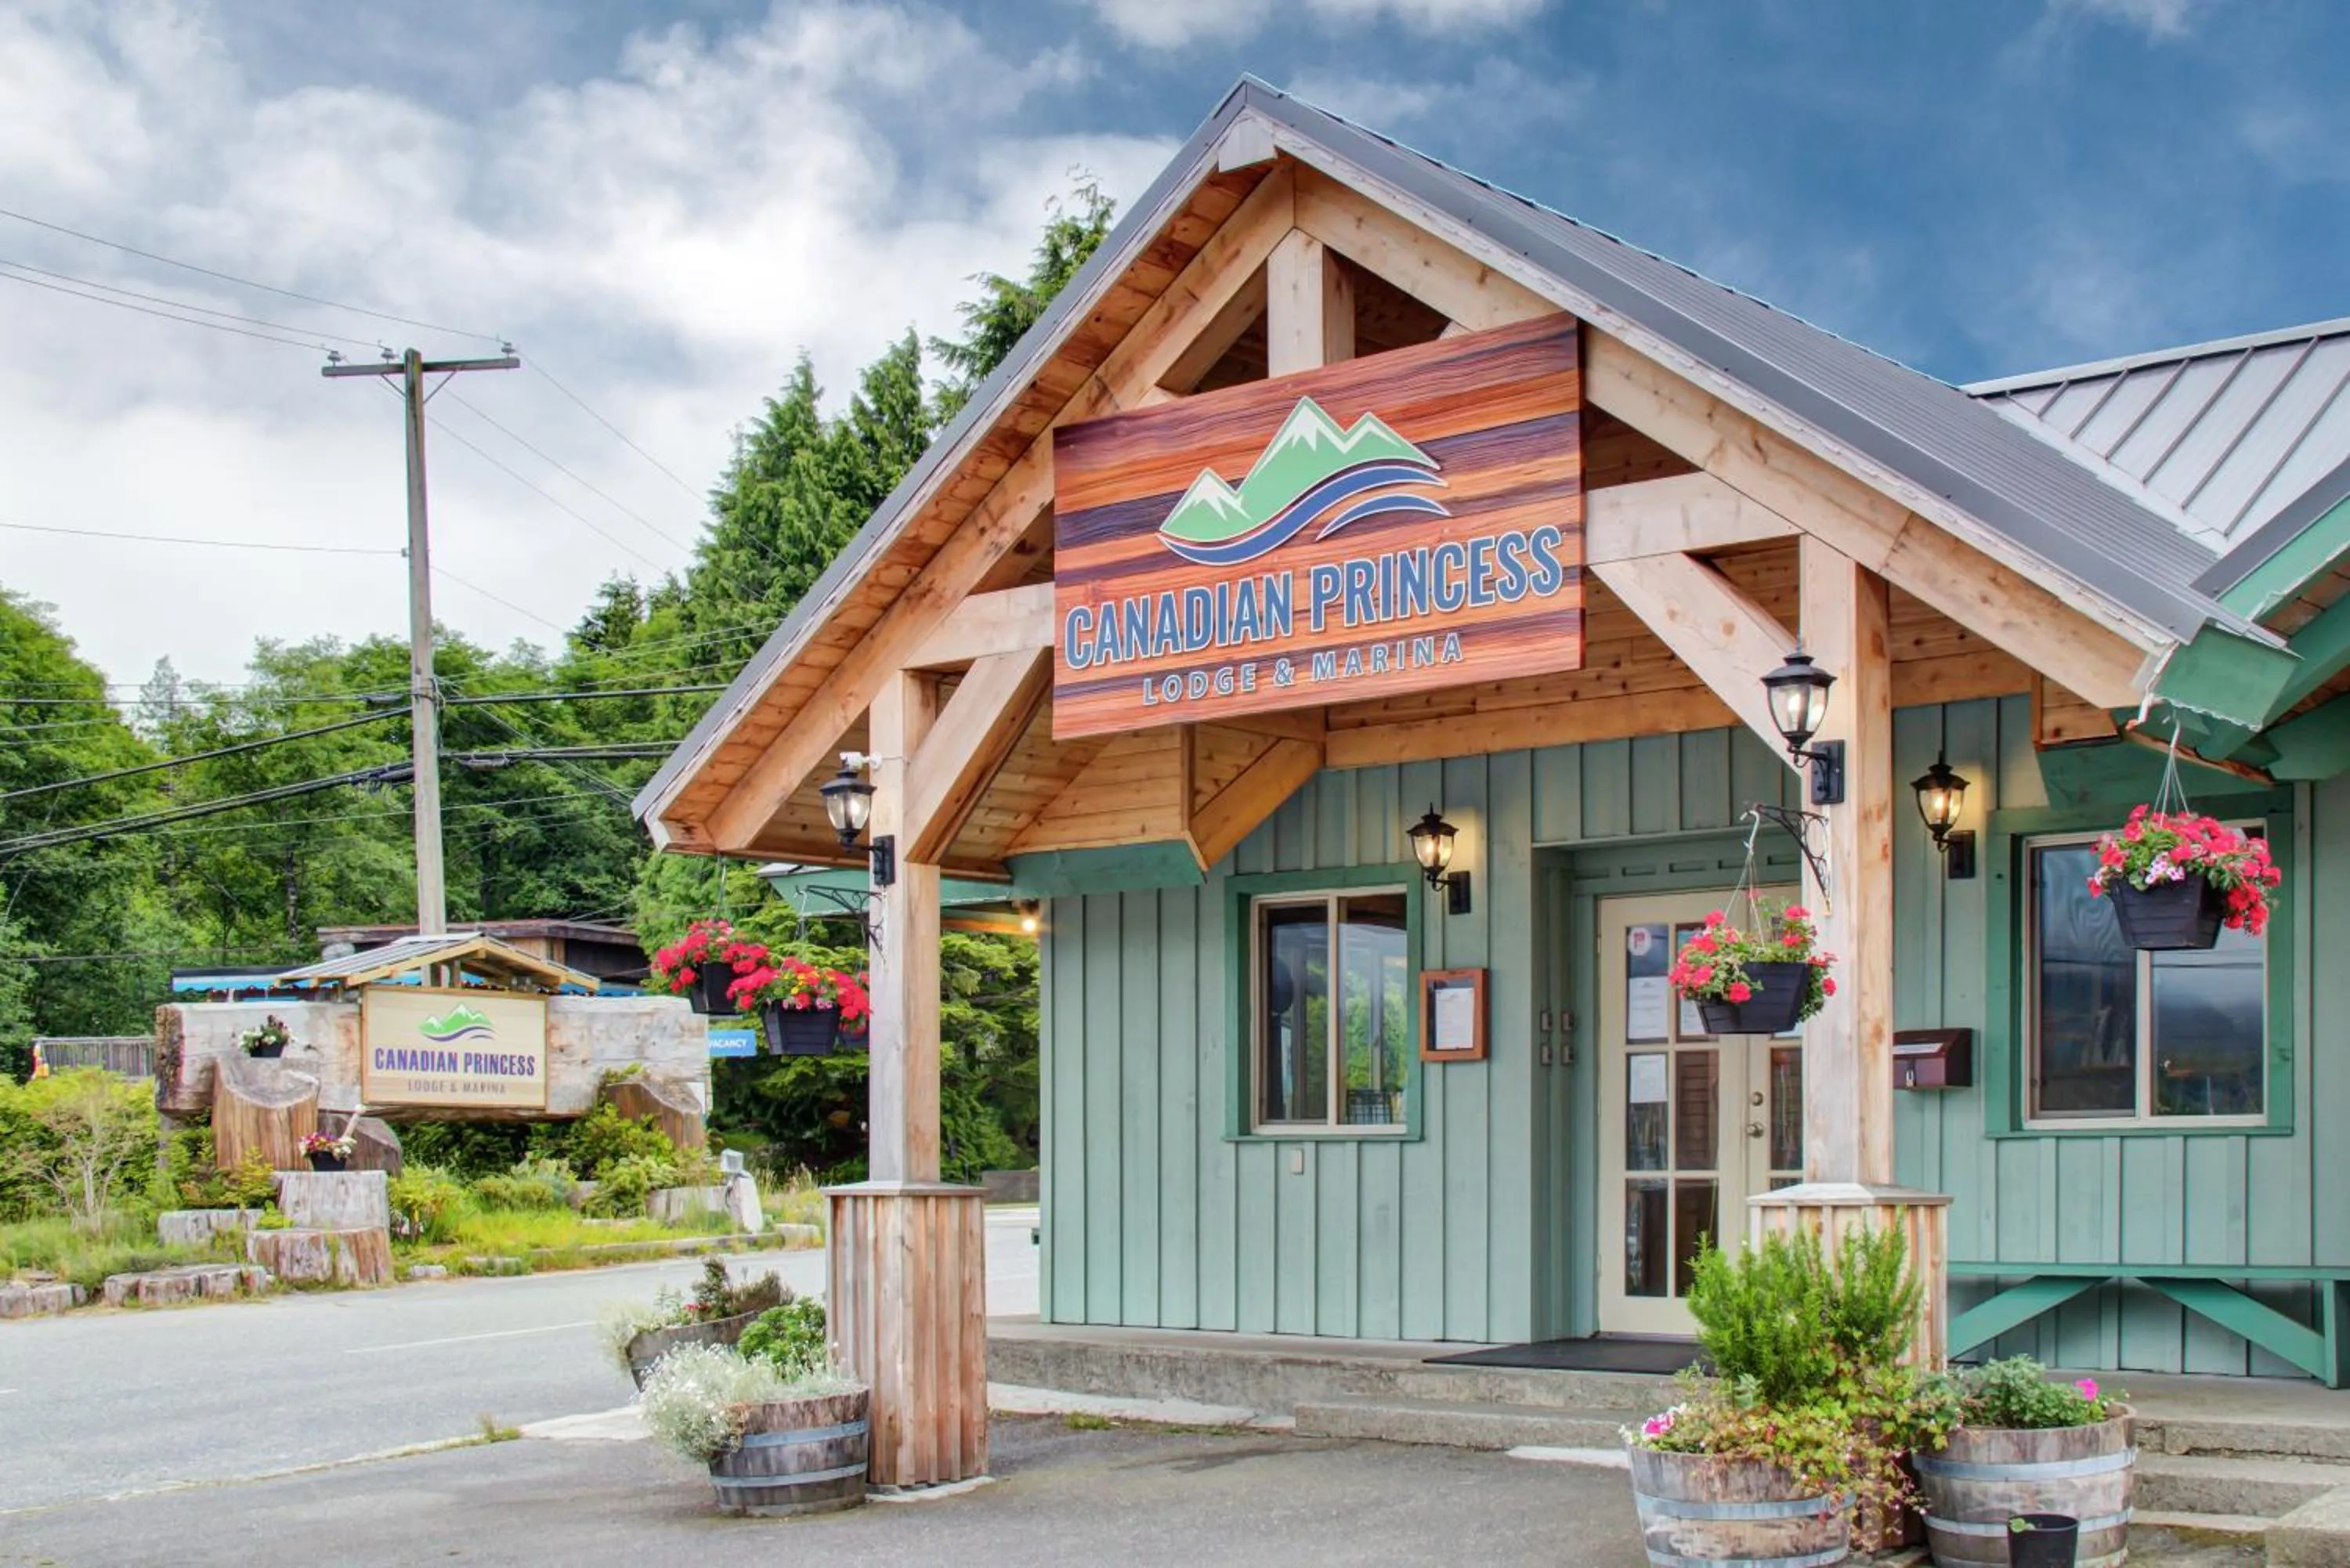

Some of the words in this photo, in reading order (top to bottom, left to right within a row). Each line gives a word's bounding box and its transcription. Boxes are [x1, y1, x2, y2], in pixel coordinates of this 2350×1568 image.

[1065, 571, 1292, 670] CANADIAN
[1311, 526, 1564, 632] PRINCESS
[1143, 663, 1256, 706] LODGE
[1274, 659, 1295, 688] &
[1313, 633, 1463, 681] MARINA
[374, 1048, 457, 1072] CANADIAN
[465, 1052, 535, 1076] PRINCESS
[408, 1078, 444, 1093] LODGE
[450, 1082, 458, 1093] &
[463, 1082, 506, 1094] MARINA
